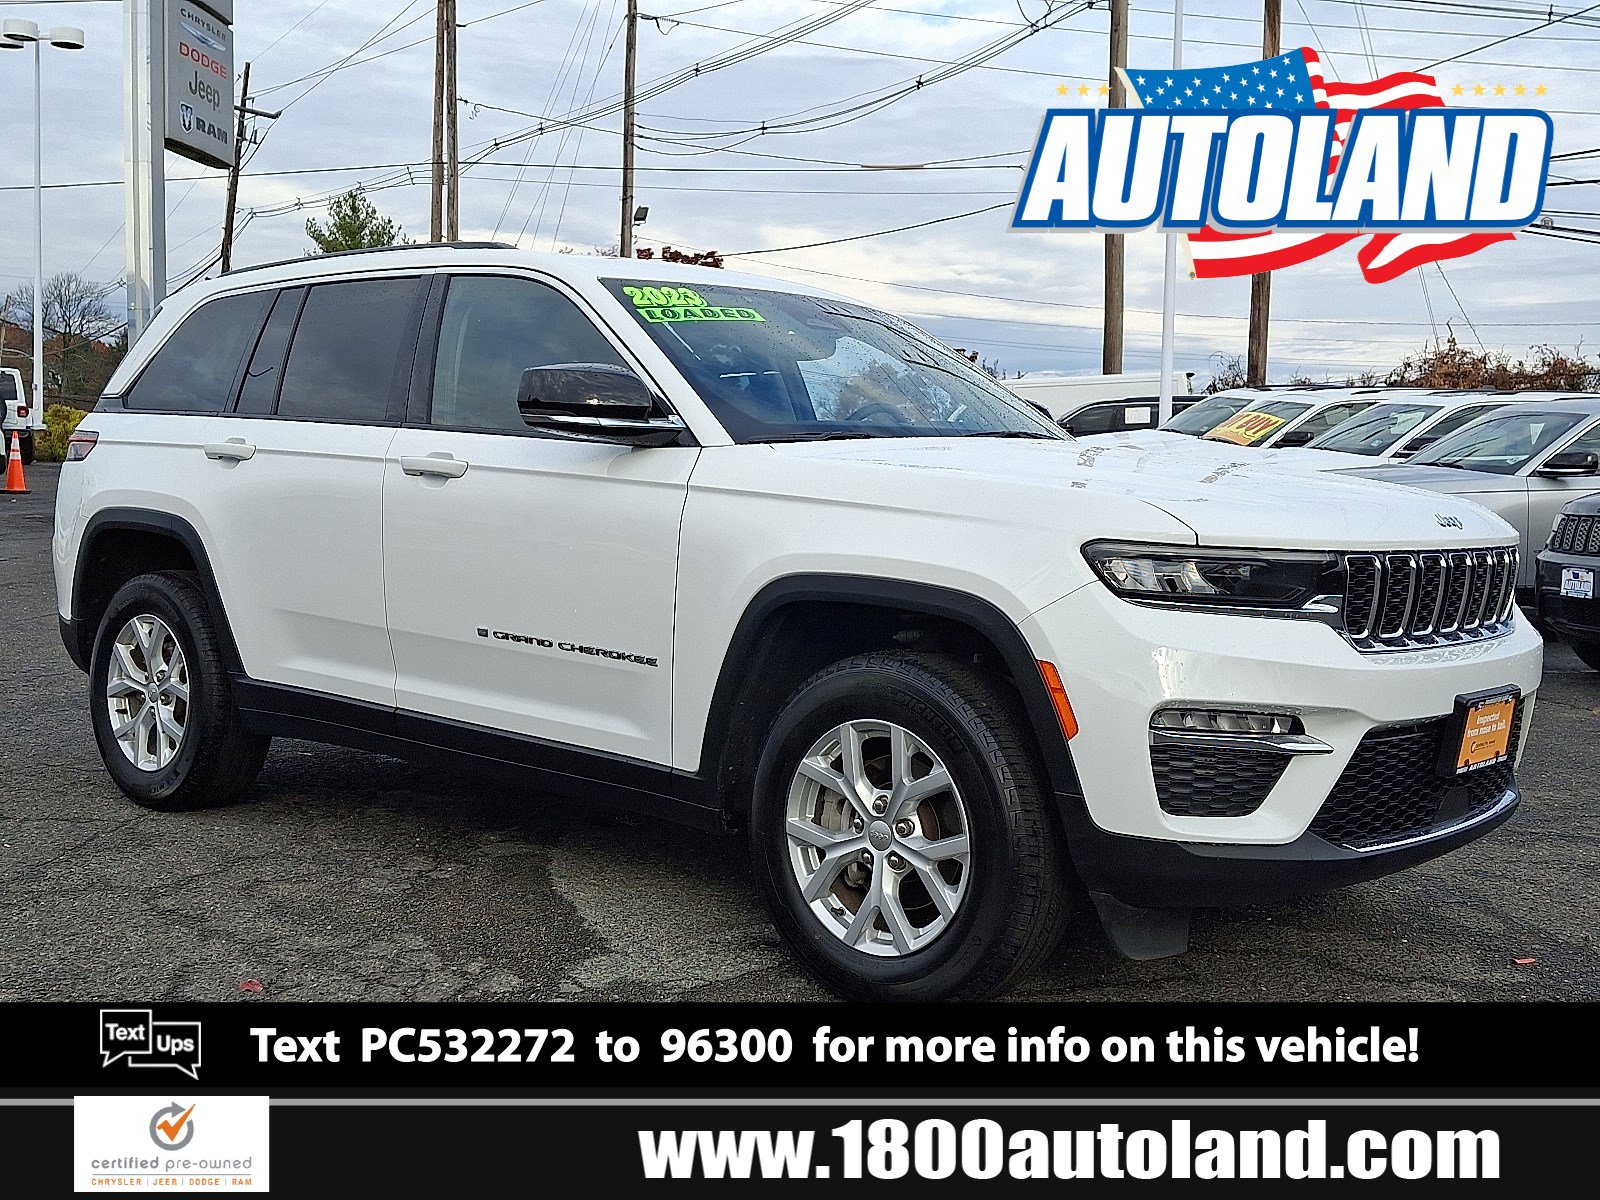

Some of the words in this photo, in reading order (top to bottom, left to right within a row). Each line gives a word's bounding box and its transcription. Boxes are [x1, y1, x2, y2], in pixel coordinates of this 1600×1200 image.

[180, 8, 226, 40] CHRYSLER
[179, 41, 227, 79] DODGE
[188, 70, 220, 111] Jeep
[196, 116, 228, 144] RAM
[622, 286, 708, 307] 2023
[645, 309, 755, 320] LOADED
[1434, 513, 1463, 530] Jeep
[492, 630, 553, 648] GRAND
[557, 641, 658, 667] CHEROKEE
[1476, 711, 1500, 725] Inspected
